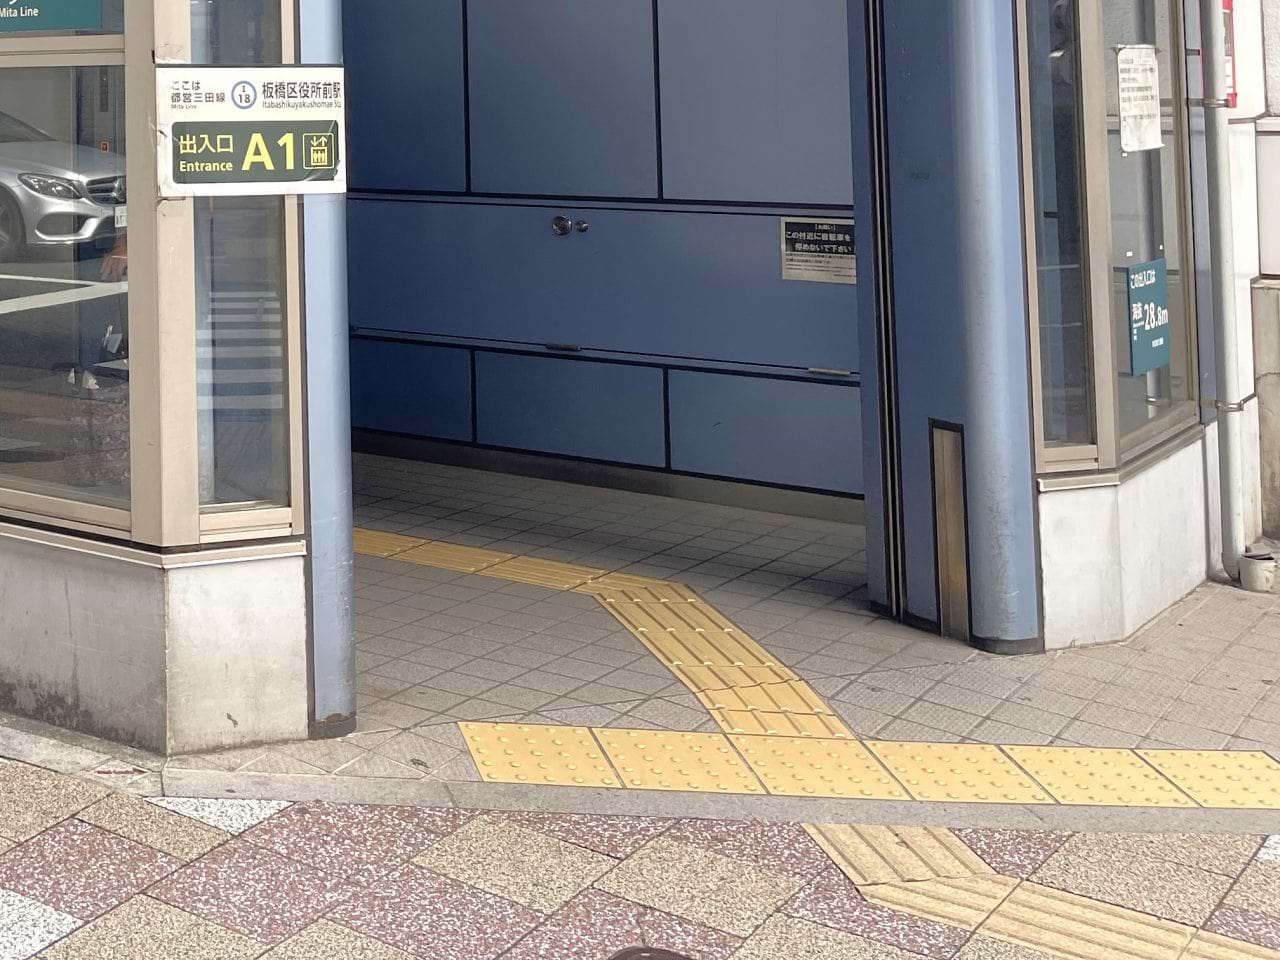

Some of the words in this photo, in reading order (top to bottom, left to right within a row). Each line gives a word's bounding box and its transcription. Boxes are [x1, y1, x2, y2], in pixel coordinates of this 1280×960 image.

[20, 6, 39, 18] Line
[171, 80, 201, 91] ここは
[261, 81, 341, 100] 板橋区役所前駅
[171, 92, 226, 103] 都営三田線
[238, 94, 251, 104] 18
[178, 133, 234, 155] 出入口
[241, 132, 295, 171] A1
[178, 160, 234, 172] Entrance
[1144, 301, 1169, 331] 28.8m
